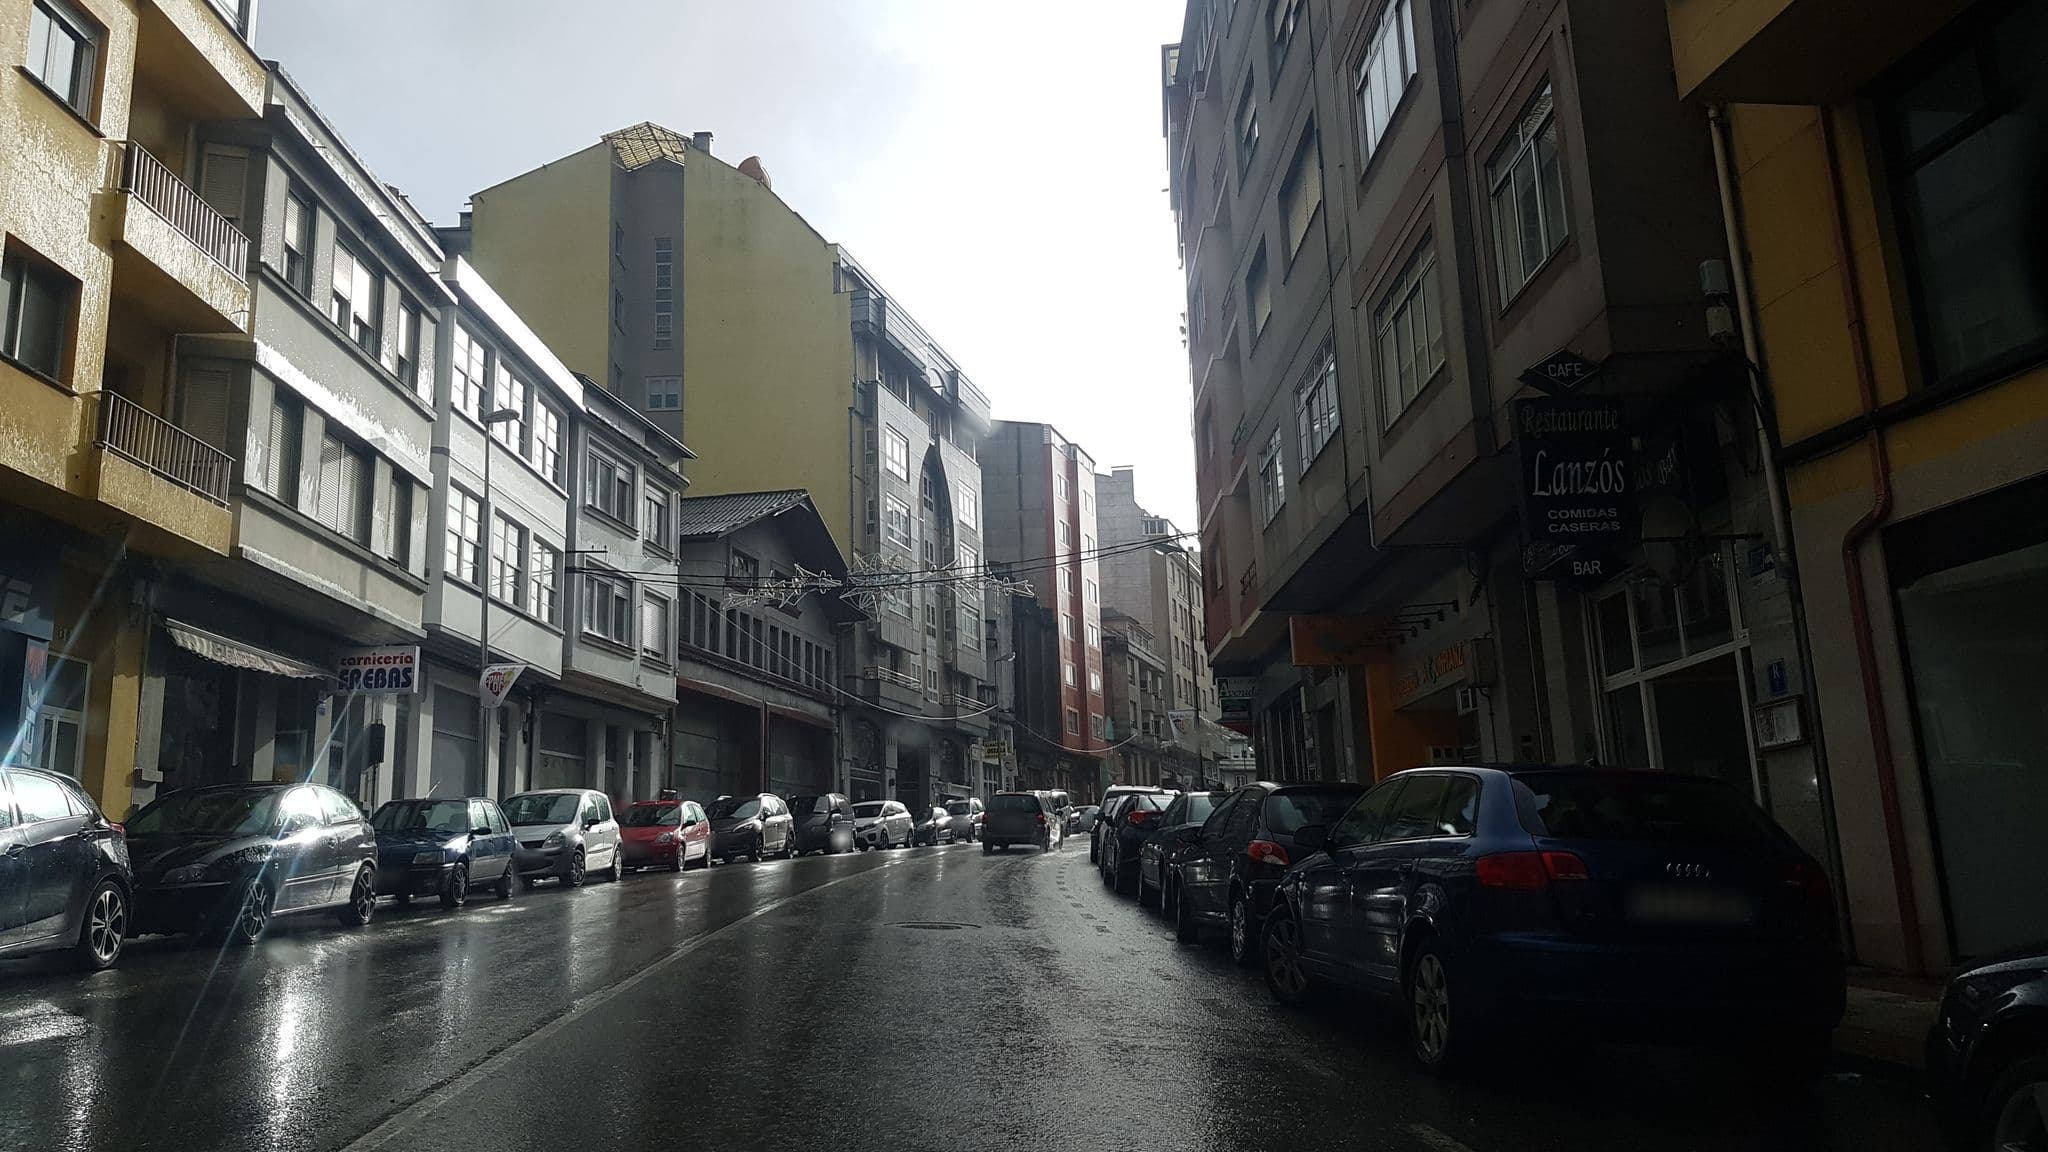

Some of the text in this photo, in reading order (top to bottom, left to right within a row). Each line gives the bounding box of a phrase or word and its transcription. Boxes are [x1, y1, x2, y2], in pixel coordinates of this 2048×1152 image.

[1547, 363, 1584, 377] CAFE
[1522, 405, 1619, 433] Restaurante
[1532, 448, 1625, 497] Lanzós
[1547, 507, 1618, 519] COMIDAS
[1547, 520, 1621, 533] CASERAS
[1573, 560, 1602, 576] BAR
[340, 652, 413, 665] carnicería
